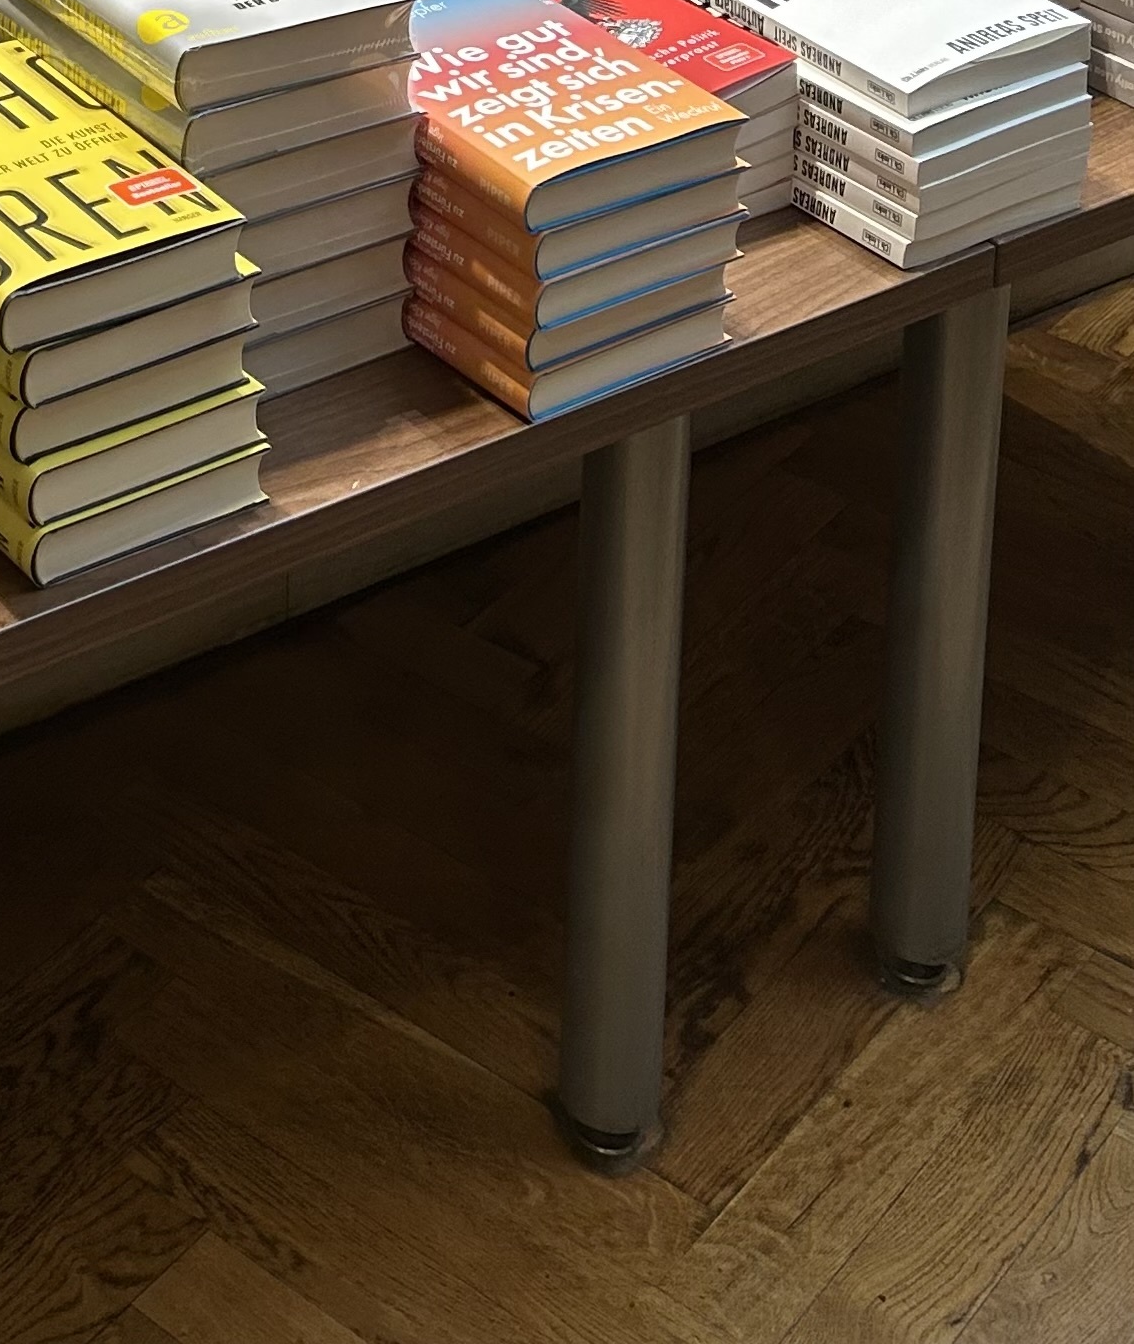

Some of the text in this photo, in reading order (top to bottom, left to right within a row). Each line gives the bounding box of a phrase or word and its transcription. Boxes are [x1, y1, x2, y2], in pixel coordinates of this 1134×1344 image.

[495, 20, 574, 58] gut
[946, 9, 1069, 56] ANDREAS SPEIT
[418, 68, 490, 103] wir
[447, 55, 642, 128] zeigt sich
[473, 79, 685, 149] in Krisen-
[16, 151, 49, 170] WELT
[39, 136, 67, 150] DIE
[512, 116, 656, 172] zeiten
